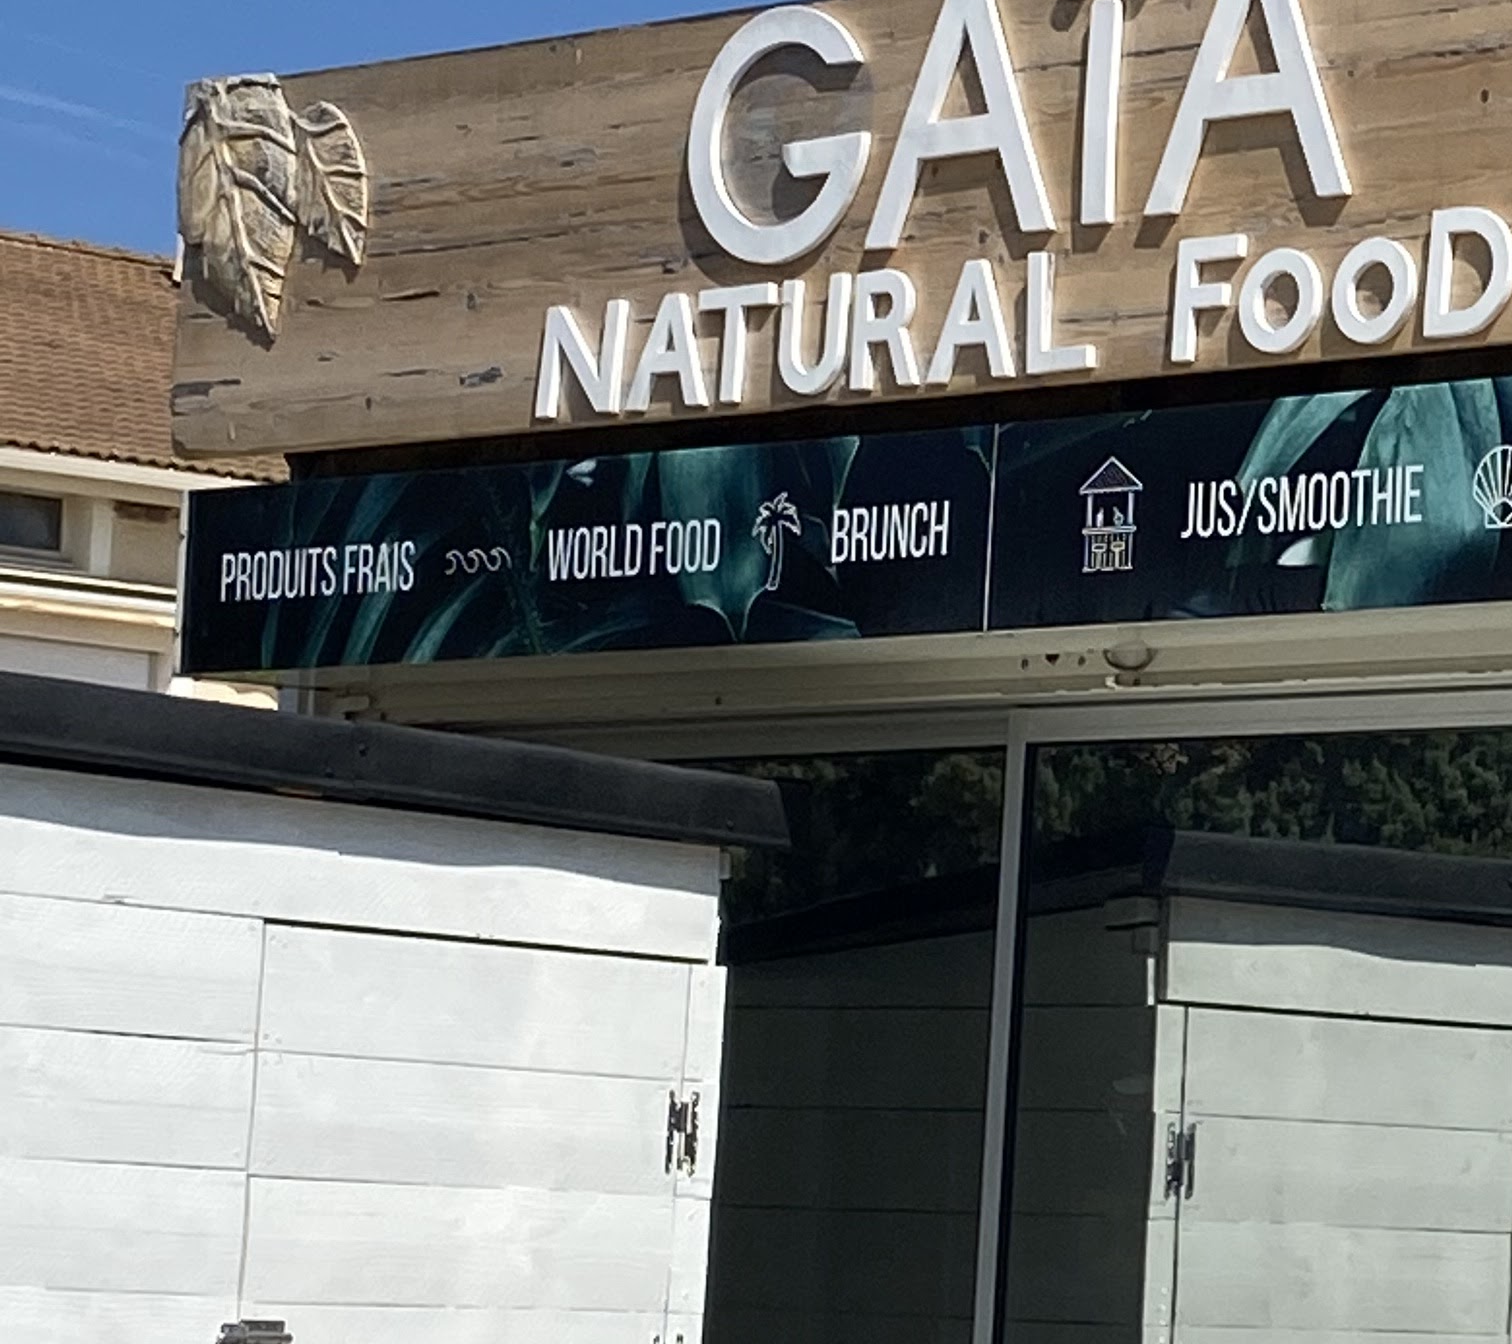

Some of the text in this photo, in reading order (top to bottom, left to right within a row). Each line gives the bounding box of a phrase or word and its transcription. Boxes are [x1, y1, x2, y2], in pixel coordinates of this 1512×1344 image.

[534, 252, 1097, 419] NATURAL
[831, 500, 950, 563] BRUNCH
[1180, 465, 1425, 539] JUS/SMOOTHIE
[220, 542, 415, 602] PRODUITS FRAIS
[548, 519, 721, 581] WORLD FOOD
